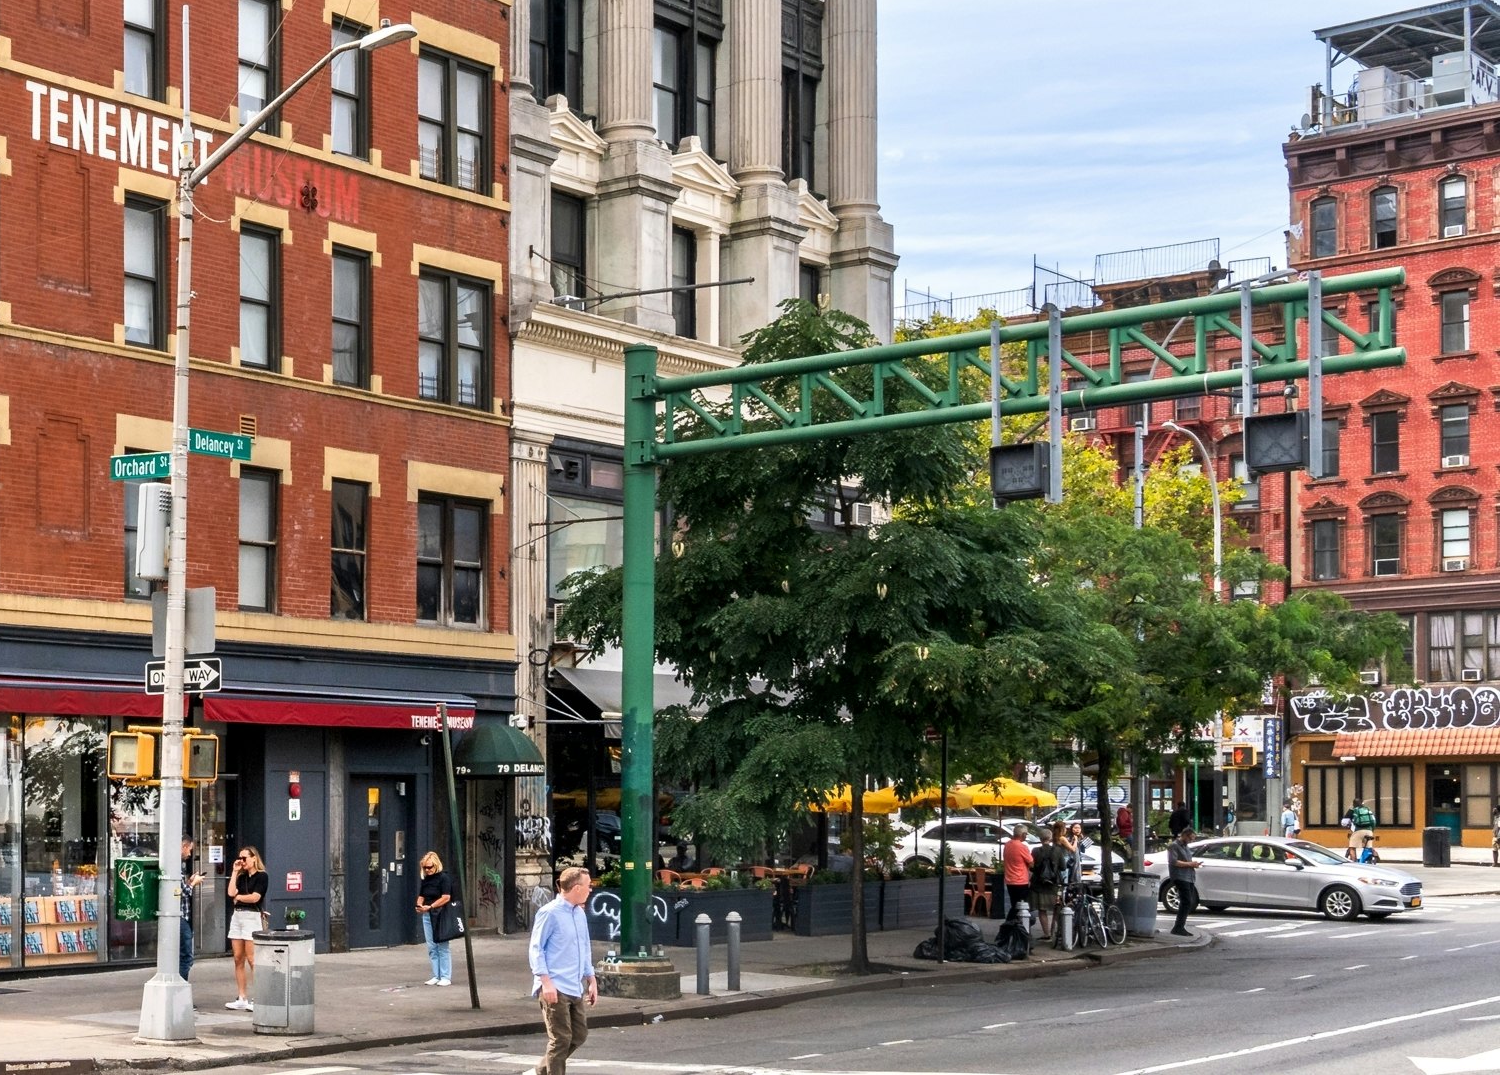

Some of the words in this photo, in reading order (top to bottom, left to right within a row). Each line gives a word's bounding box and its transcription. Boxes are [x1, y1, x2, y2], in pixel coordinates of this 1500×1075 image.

[225, 141, 359, 224] MUSEUM
[195, 433, 234, 458] Delancey
[237, 439, 243, 450] St
[114, 457, 155, 477] Orchard
[160, 456, 168, 467] St
[189, 670, 212, 681] WAY
